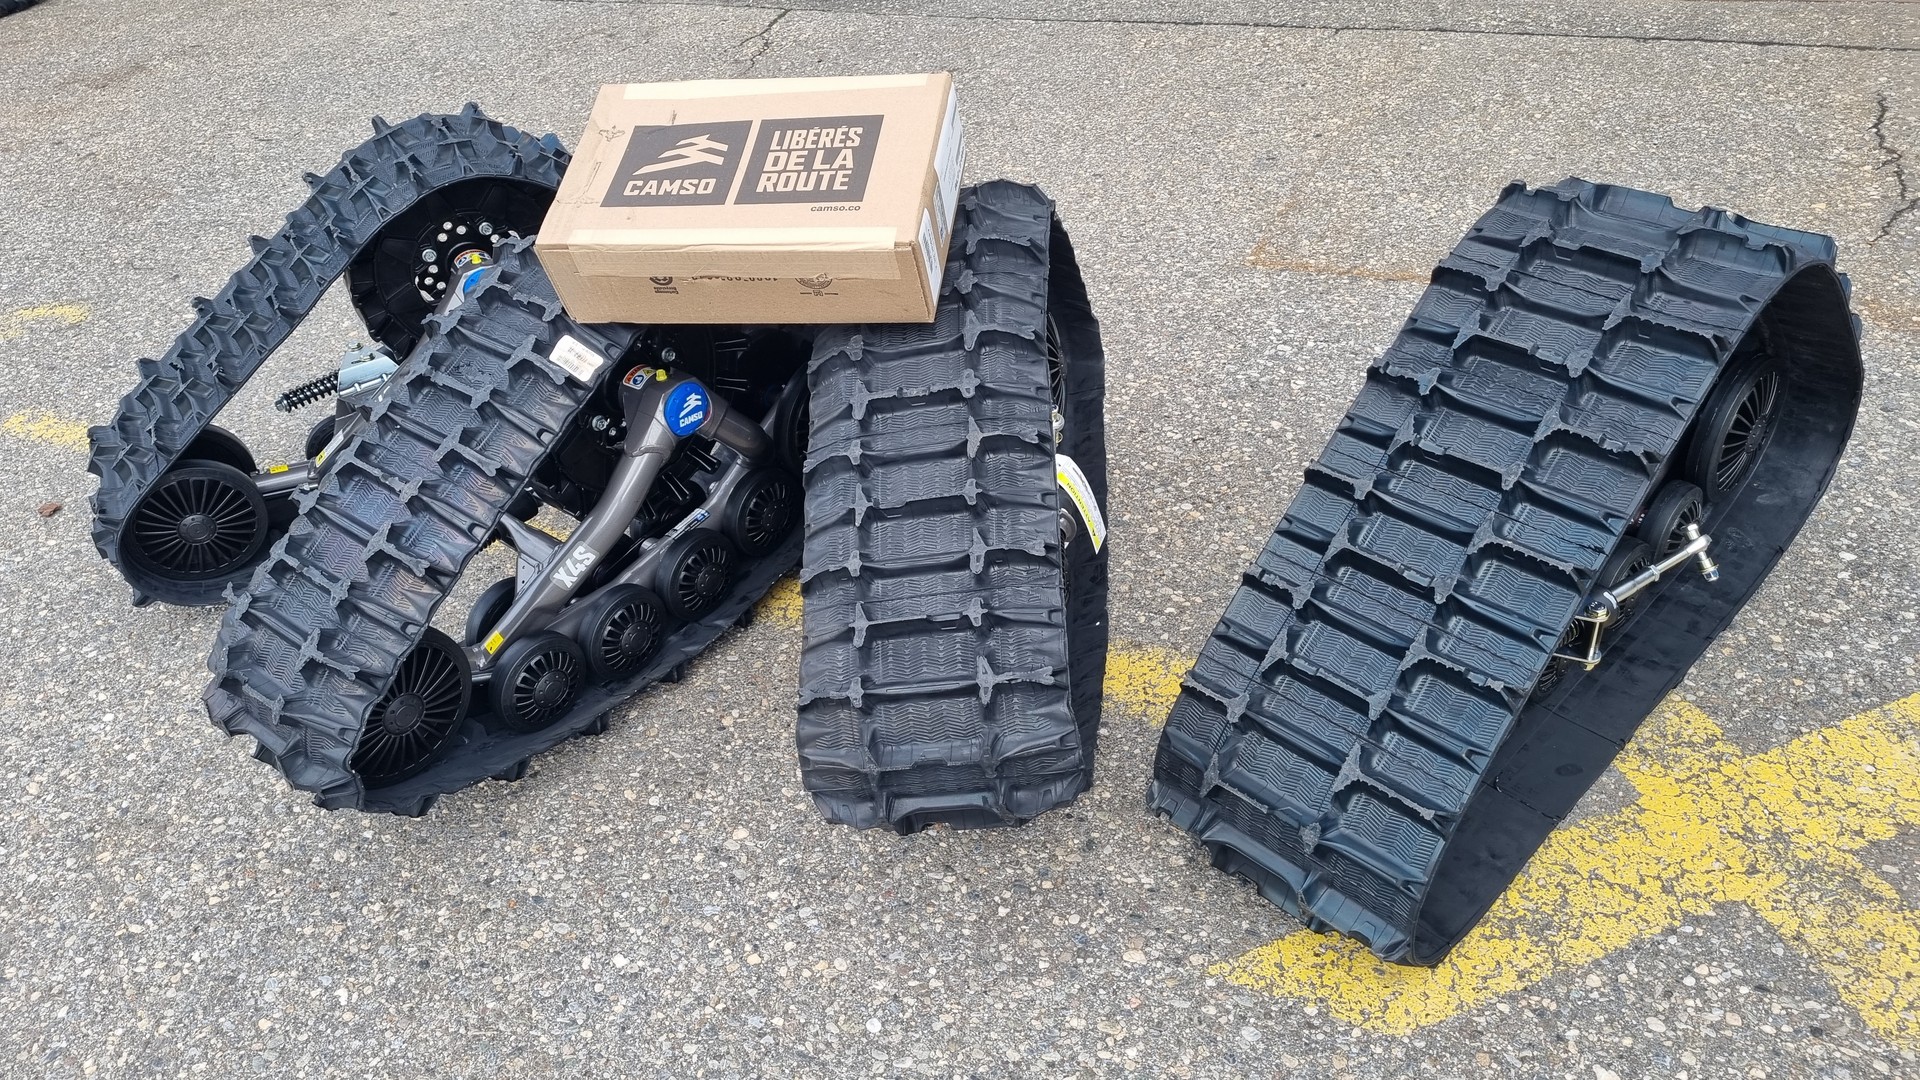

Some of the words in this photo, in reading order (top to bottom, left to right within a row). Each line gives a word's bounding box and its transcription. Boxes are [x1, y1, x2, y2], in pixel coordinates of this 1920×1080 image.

[769, 126, 863, 150] LIBÉRÉS
[762, 150, 809, 172] DE
[812, 149, 854, 170] LA
[623, 178, 717, 196] CAMSO
[756, 170, 852, 193] ROUTE
[679, 411, 703, 428] CAMSO
[1066, 482, 1091, 523] ATTENTION
[553, 545, 596, 588] X4S
